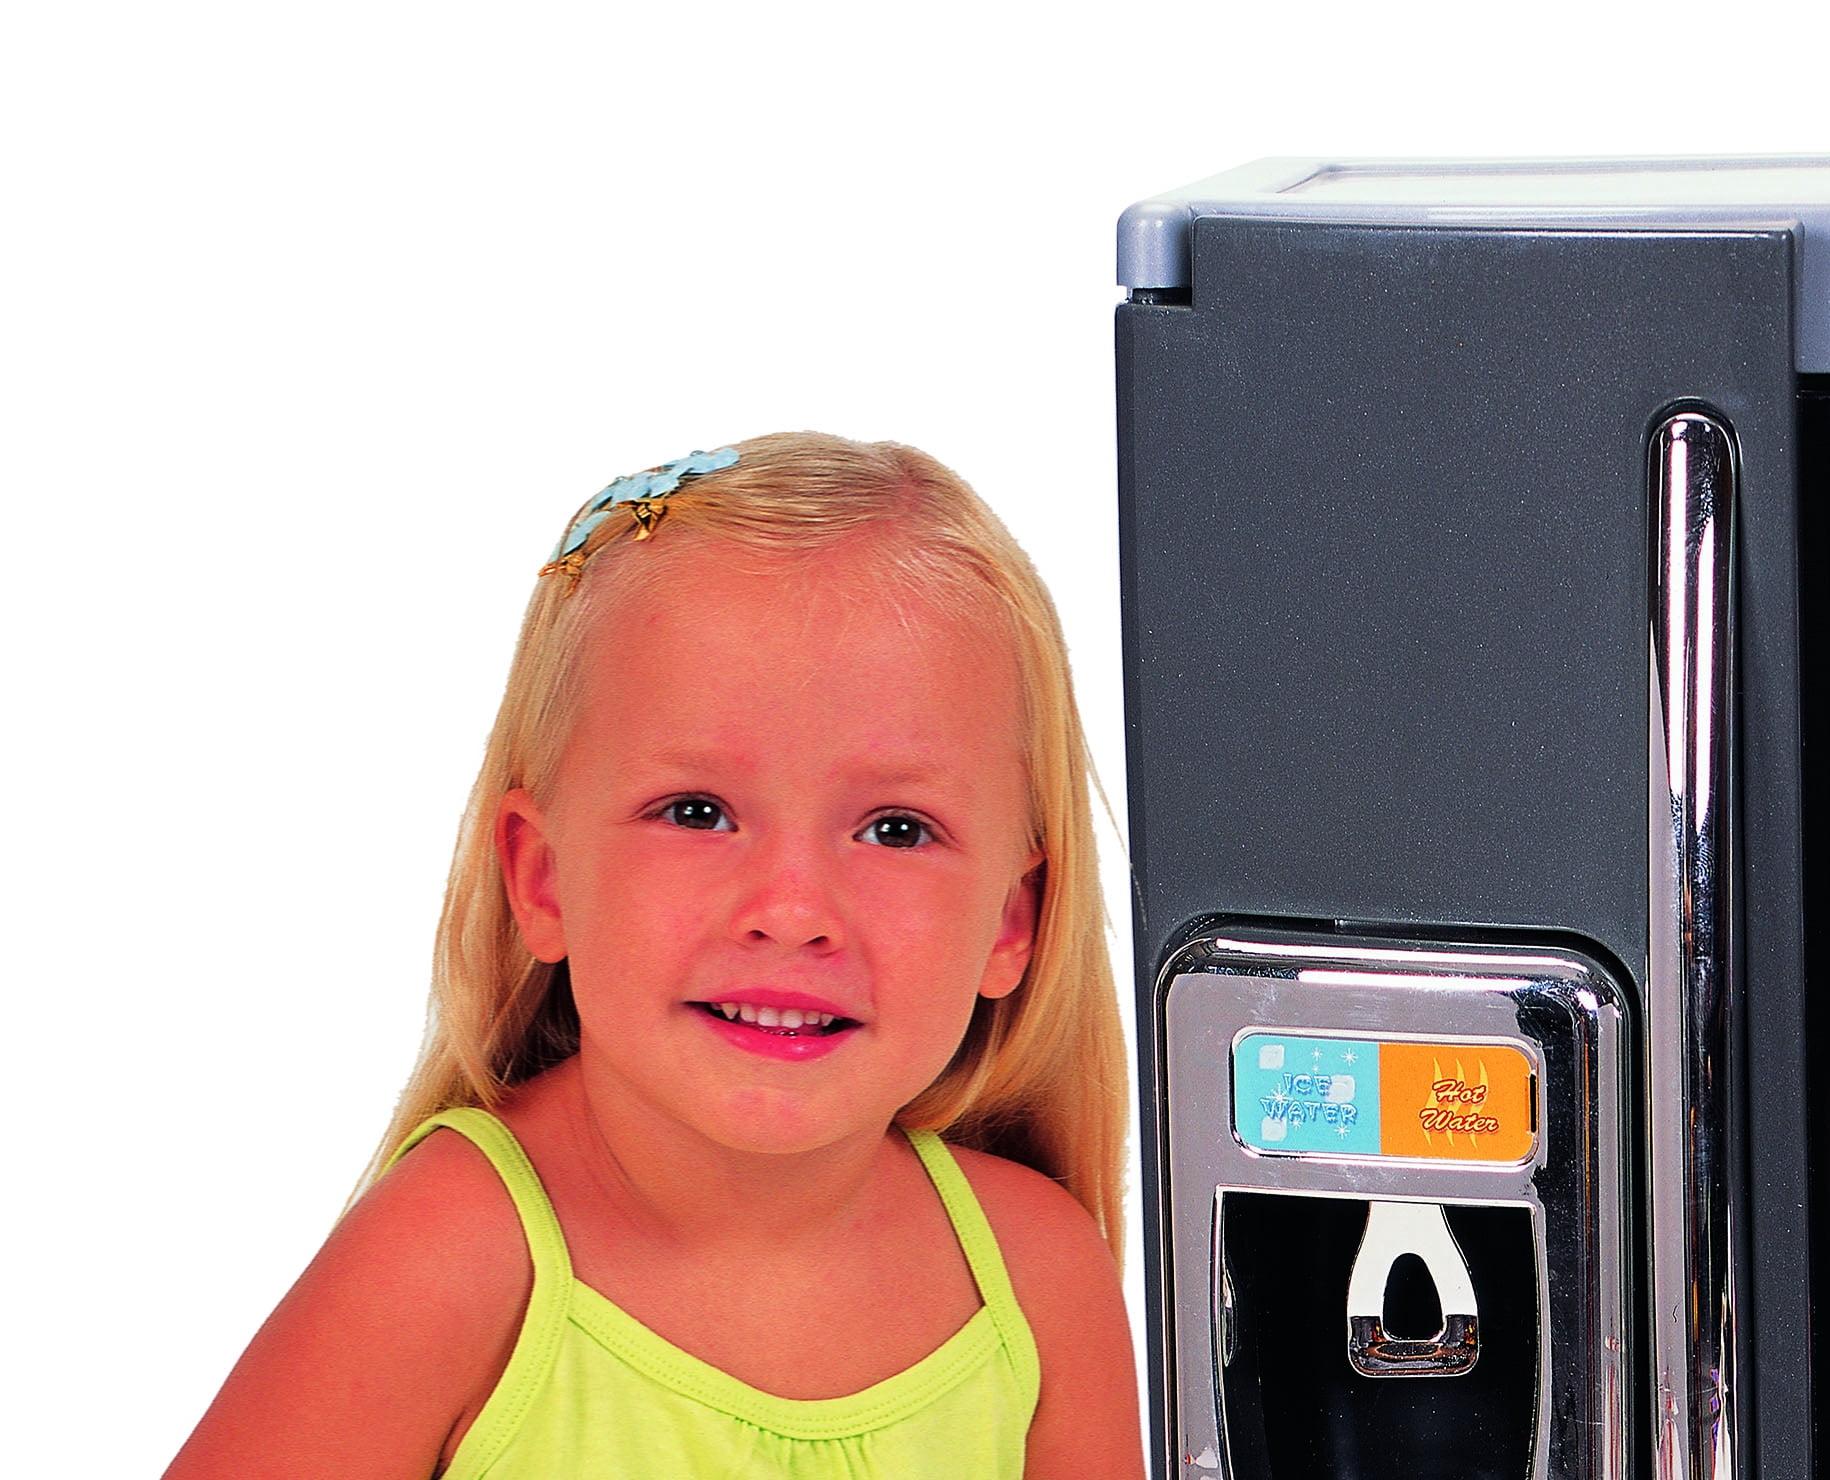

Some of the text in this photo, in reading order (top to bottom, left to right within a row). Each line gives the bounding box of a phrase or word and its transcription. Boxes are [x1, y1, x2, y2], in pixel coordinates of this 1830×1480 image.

[1283, 1073, 1333, 1097] ICE
[1432, 1078, 1489, 1105] Hot
[1260, 1098, 1358, 1126] WATER
[1419, 1108, 1500, 1133] Water
